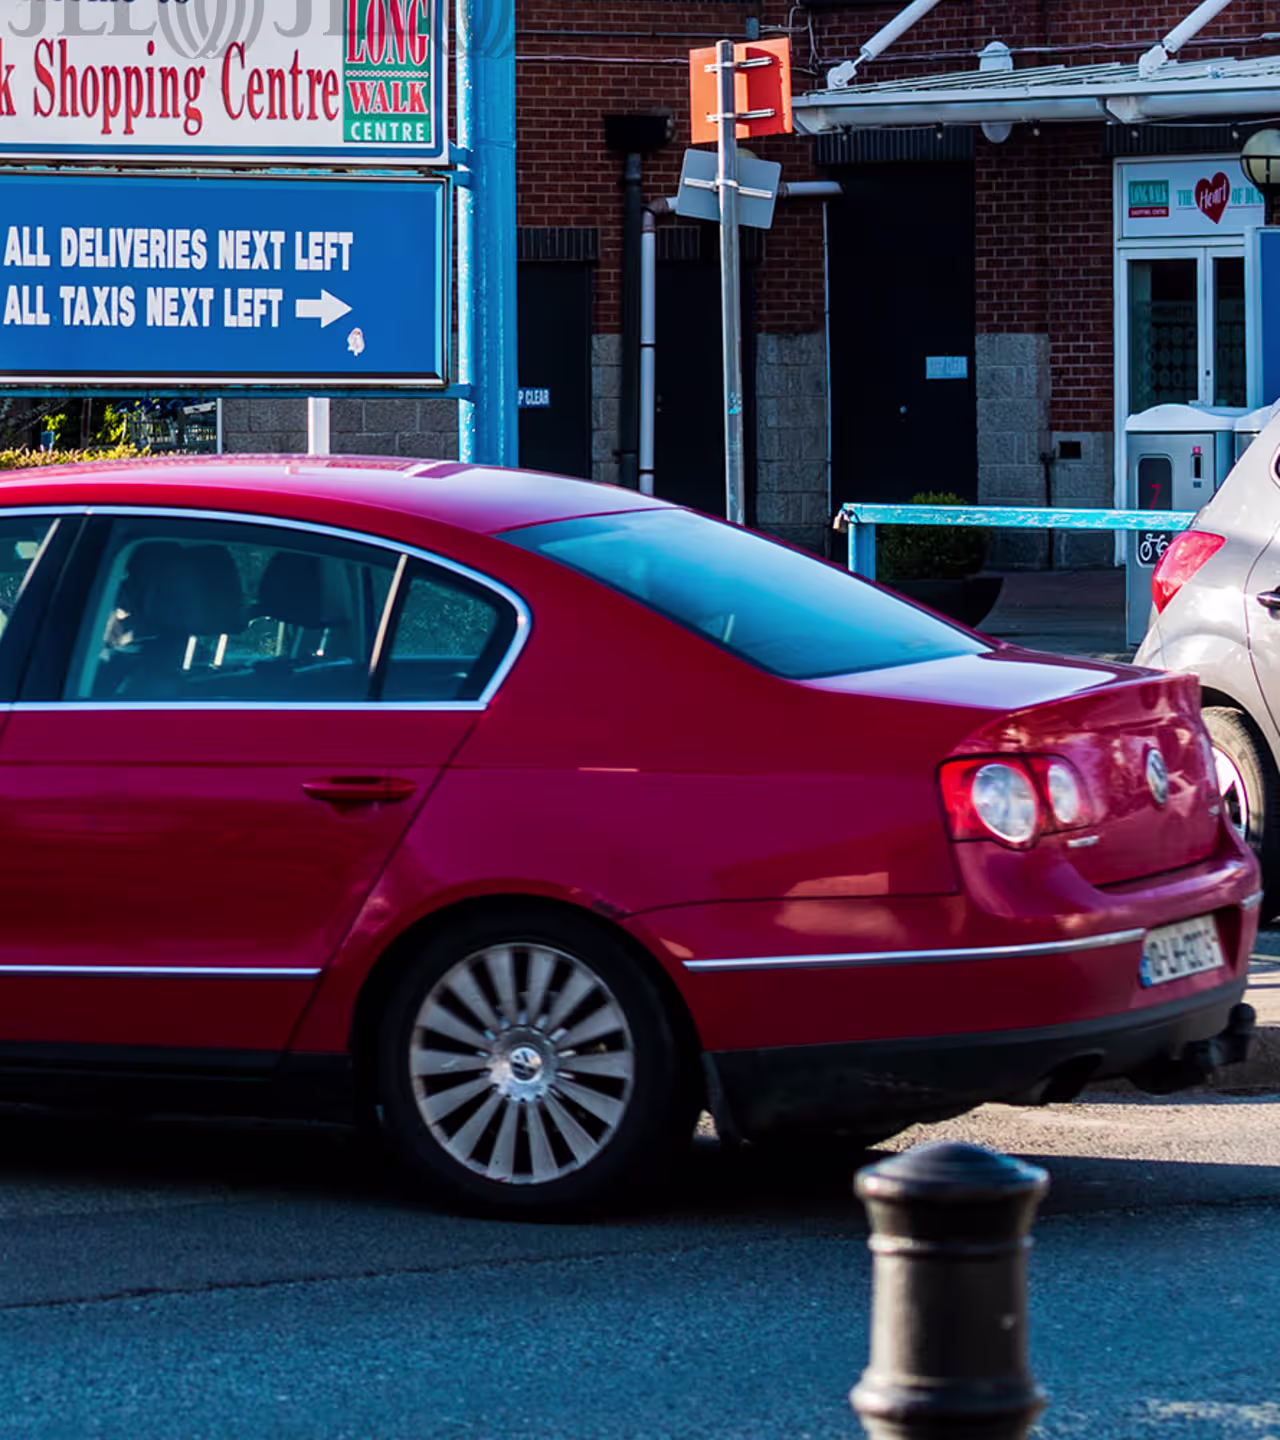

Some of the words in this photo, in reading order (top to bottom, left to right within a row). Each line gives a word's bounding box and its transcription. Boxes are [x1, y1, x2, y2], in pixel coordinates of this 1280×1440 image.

[34, 37, 206, 136] Shopping
[221, 41, 340, 123] Centre
[347, 80, 428, 115] WALK
[351, 122, 425, 142] CENTRE
[1200, 179, 1227, 209] Heart
[3, 226, 51, 267] ALL
[60, 226, 208, 270] DELIVERIES
[218, 230, 285, 271] NEXT
[295, 231, 354, 272] LEFT
[3, 285, 51, 326] ALL
[59, 286, 136, 328] TAXIS
[147, 288, 214, 328] NEXT
[224, 288, 283, 329] LEFT
[525, 389, 549, 406] CLEAR
